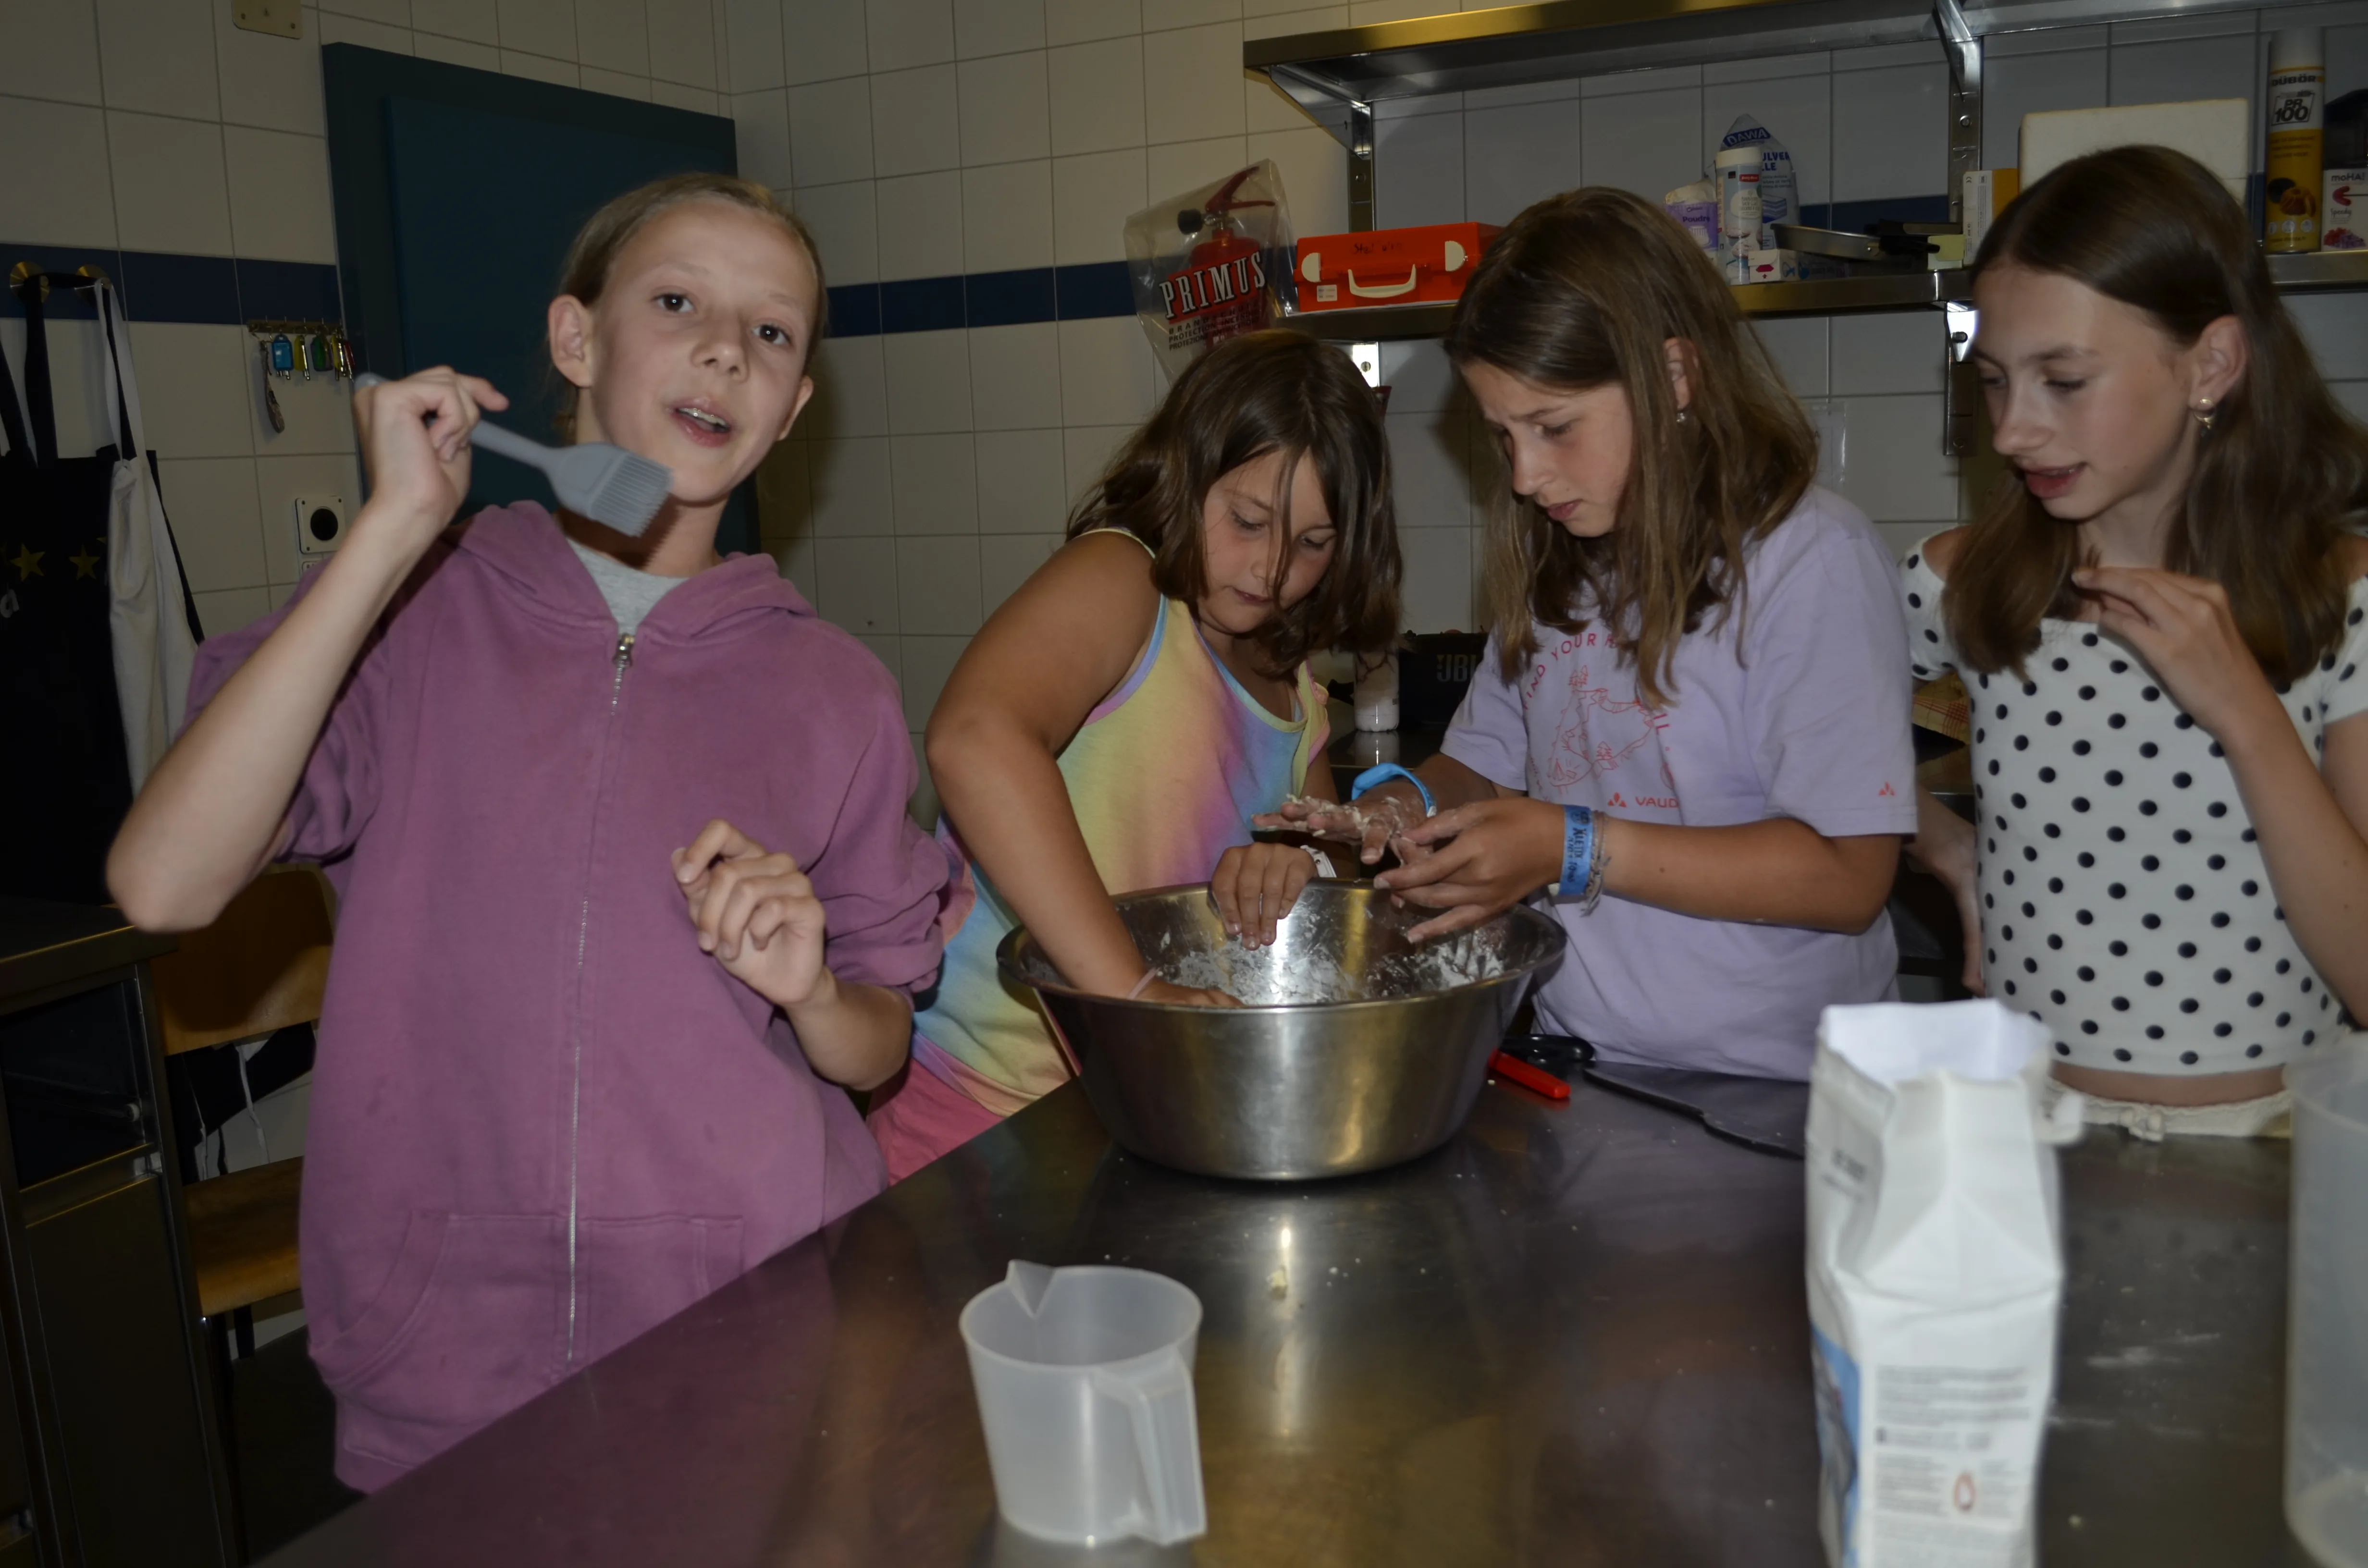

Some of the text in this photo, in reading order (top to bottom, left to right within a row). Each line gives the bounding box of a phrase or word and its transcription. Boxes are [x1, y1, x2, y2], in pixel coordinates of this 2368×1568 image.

[2271, 74, 2316, 86] DÜBÖR
[2284, 99, 2303, 110] PR
[2275, 106, 2308, 122] 100
[1727, 129, 1768, 146] DAWA
[1159, 250, 1268, 320] PRIMUS
[1169, 320, 1216, 343] PROTECTION
[1551, 633, 1598, 661] YOUR
[1636, 796, 1679, 808] VAUD
